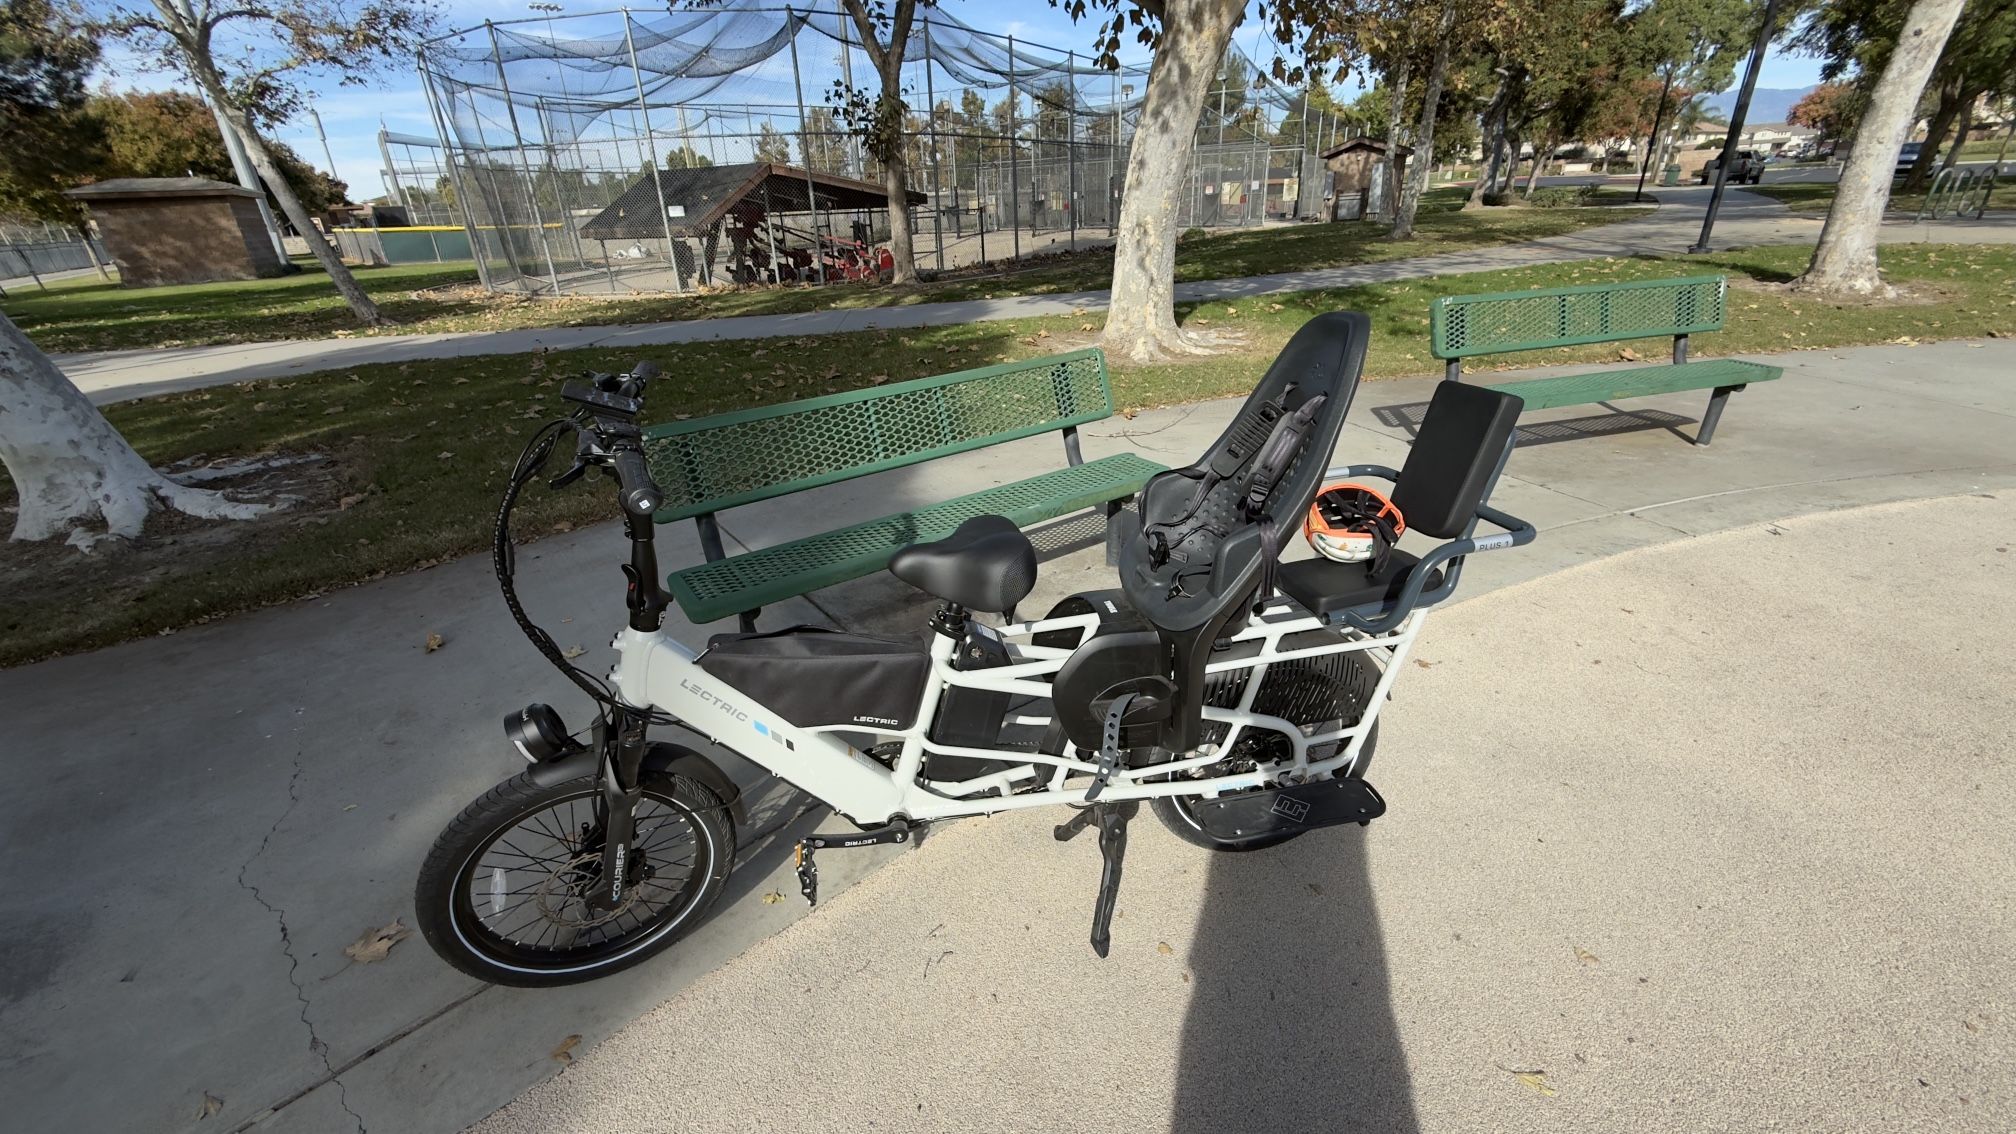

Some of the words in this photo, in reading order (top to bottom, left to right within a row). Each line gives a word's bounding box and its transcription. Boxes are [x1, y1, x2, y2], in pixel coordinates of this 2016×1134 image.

[1480, 541, 1502, 551] PLUS
[680, 678, 748, 722] LECTRIC
[853, 716, 899, 725] LECTRIC
[845, 838, 877, 846] LECTRIC
[612, 849, 625, 896] COURIER
